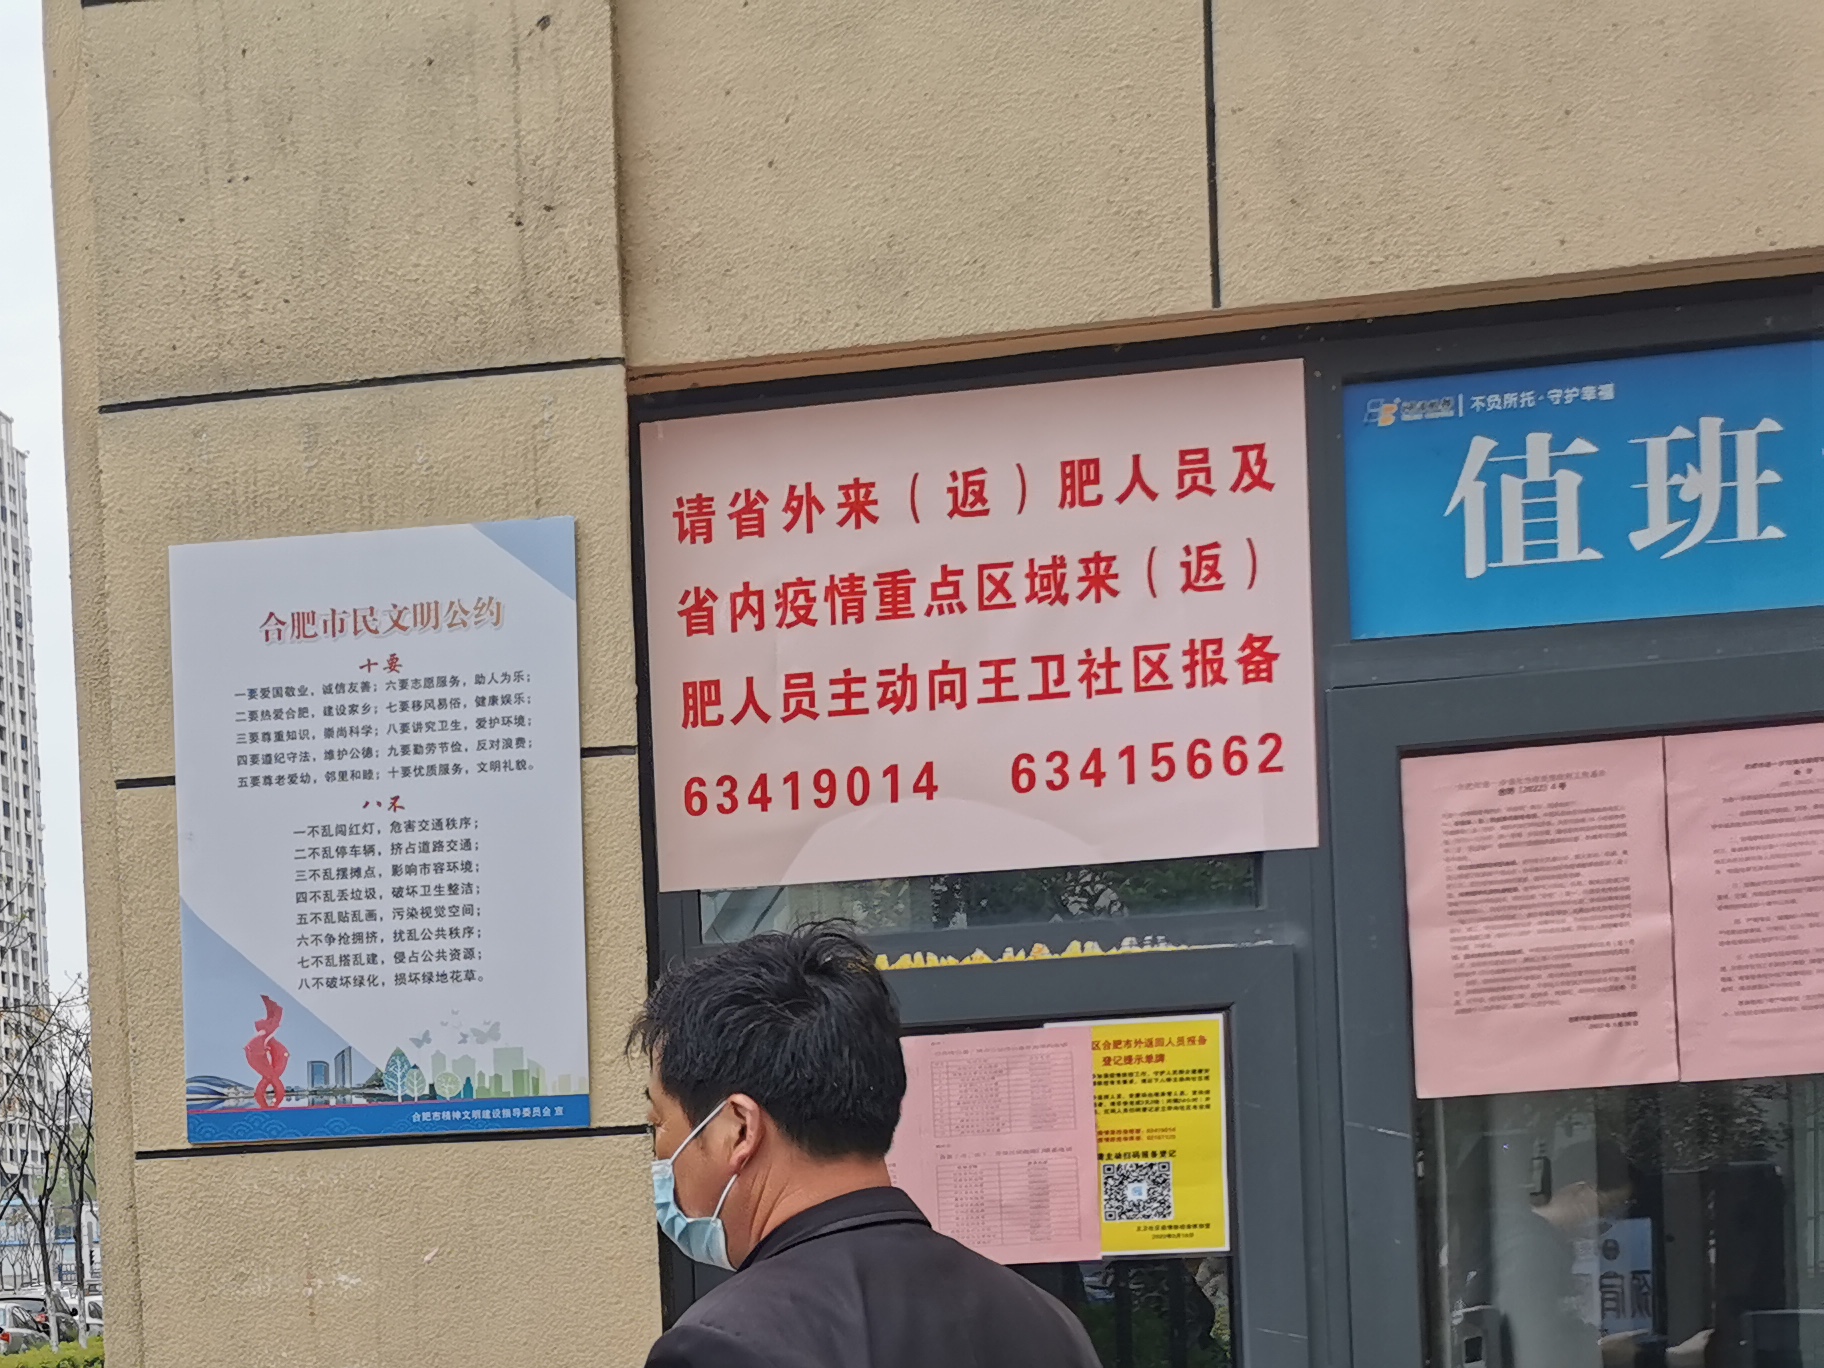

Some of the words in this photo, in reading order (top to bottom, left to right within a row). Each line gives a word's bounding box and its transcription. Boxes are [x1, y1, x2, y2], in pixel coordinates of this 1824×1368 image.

[673, 441, 1276, 546] 请省外来（返）肥人员及
[1442, 416, 1787, 579] 值班
[259, 595, 503, 643] 合肥市民文明公约
[676, 537, 1259, 638] 省内疫情重点区域来（返）
[358, 652, 404, 674] 十要
[681, 632, 1280, 729] 肥人员主动向王卫社区报备
[362, 795, 405, 813] 八不
[683, 760, 939, 818] 63419014
[1010, 732, 1285, 794] 63415662
